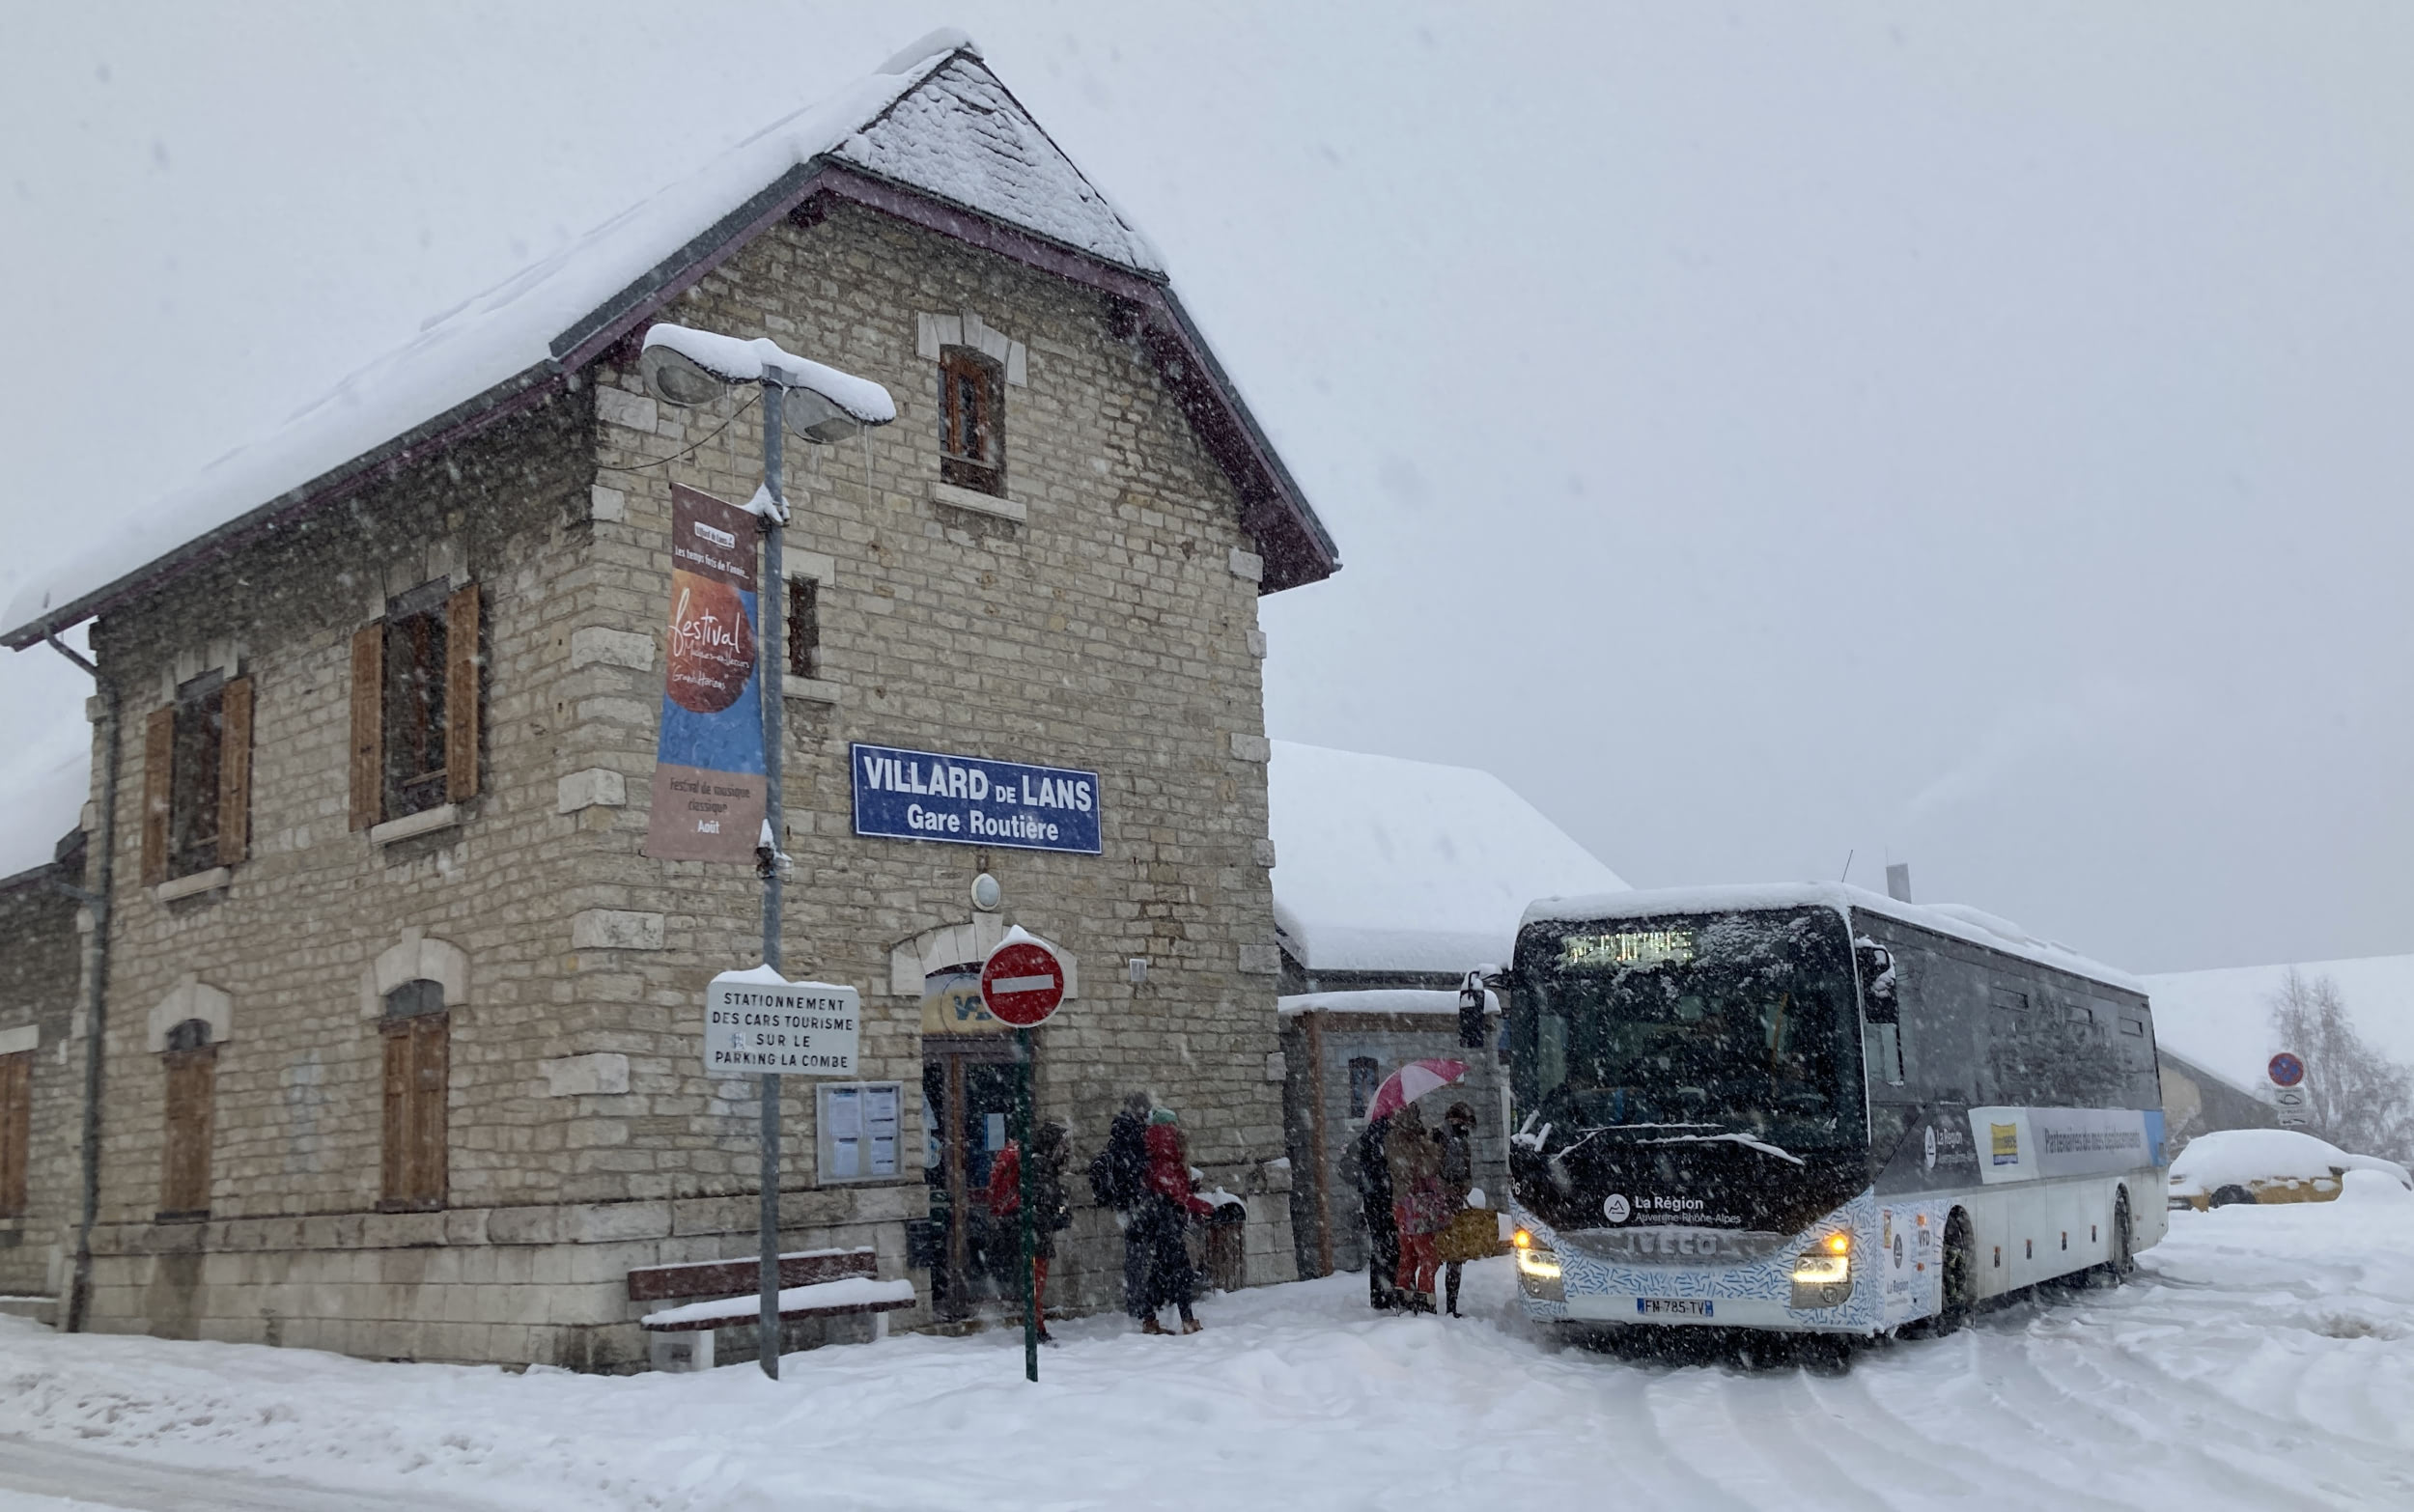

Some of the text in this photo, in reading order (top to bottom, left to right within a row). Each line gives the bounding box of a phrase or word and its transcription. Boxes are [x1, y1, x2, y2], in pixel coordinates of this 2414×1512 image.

[675, 545, 686, 557] Les
[687, 548, 705, 564] temps
[717, 560, 726, 571] de
[670, 777, 750, 800] Festival de musique
[863, 755, 1092, 812] VILLARD DE LANS
[697, 819, 720, 835] Août
[907, 803, 1059, 841] Gare Routière
[724, 993, 845, 1011] STATIONNEMENT
[713, 1011, 854, 1031] DES CARS TOURISME
[756, 1033, 811, 1048] SUR LE
[716, 1050, 848, 1068] PARKING LA COMBE
[1635, 1195, 1704, 1212] La Région
[1635, 1212, 1742, 1224] Auvergne-Rhône-Alpes
[1626, 1232, 1718, 1255] IVECO
